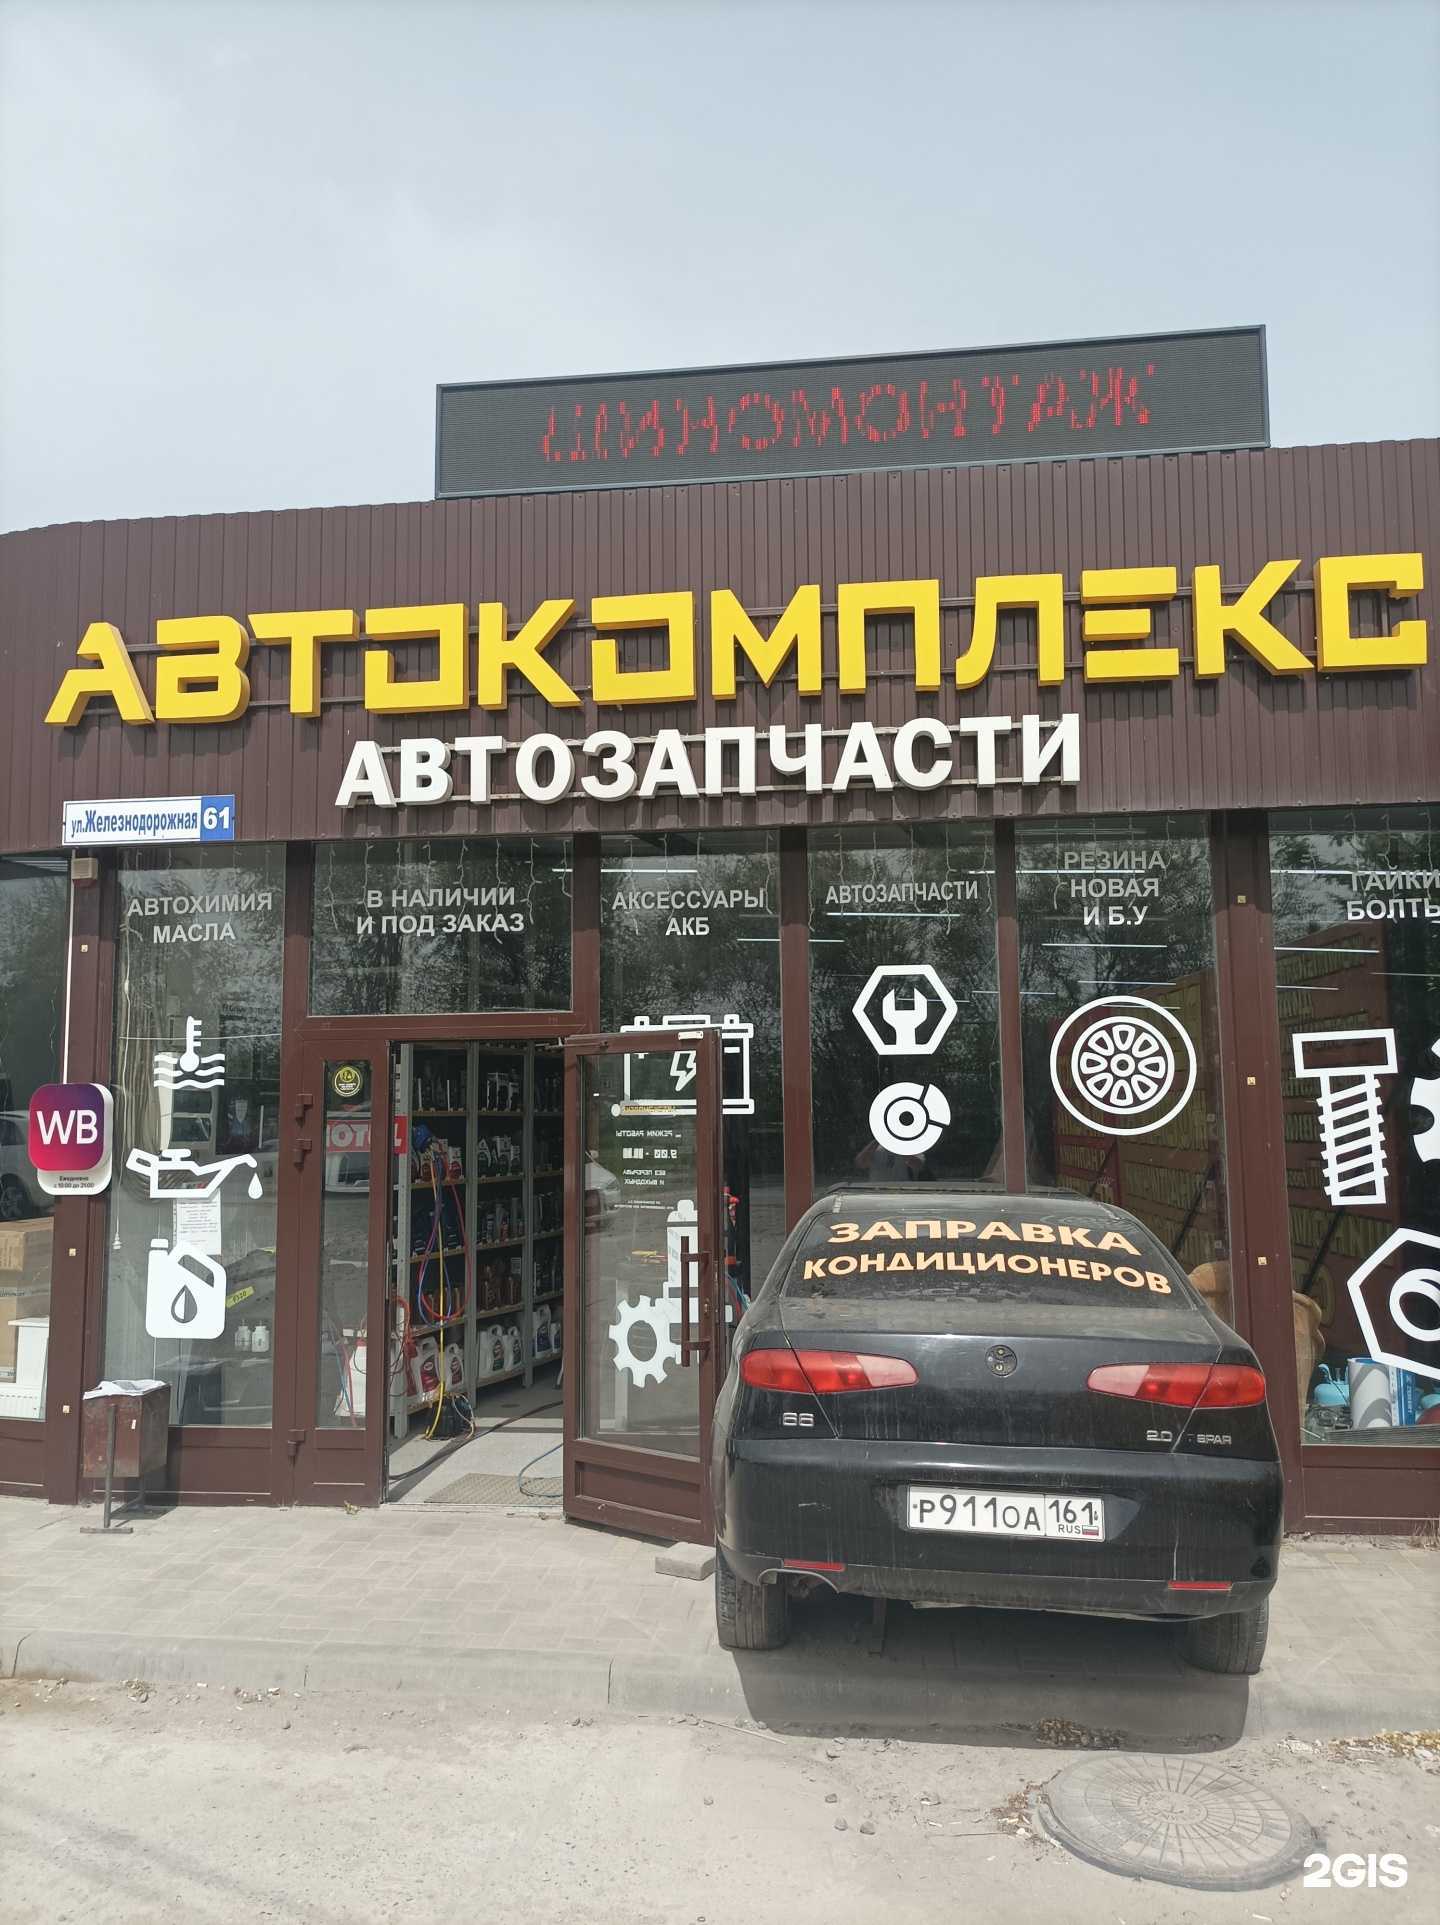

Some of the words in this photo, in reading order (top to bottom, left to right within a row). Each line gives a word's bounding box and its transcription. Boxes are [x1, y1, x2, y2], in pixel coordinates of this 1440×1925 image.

[541, 362, 1156, 462] ШИНОМОНТАЖ
[44, 552, 1428, 726] АВТОКОМПЛЕКС
[335, 713, 1080, 808] АВТОЗАПЧАСТИ
[203, 806, 230, 829] 61
[1064, 851, 1166, 871] РЕЗИНА
[366, 890, 383, 908] В
[392, 887, 516, 908] НАЛИЧИИ
[611, 889, 765, 911] АКСЕССУАРЫ
[825, 880, 980, 905] АВТОЗАПЧАСТИ
[1071, 878, 1160, 898] НОВАЯ
[127, 892, 273, 917] АВТОХИМИЯ
[1083, 905, 1100, 926] И
[1108, 904, 1149, 926] Б.У
[153, 922, 236, 945] МАСЛА
[357, 915, 373, 935] И
[381, 913, 435, 937] ПОД
[441, 911, 525, 935] ЗАКАЗ
[665, 916, 710, 936] АКБ
[36, 1109, 98, 1145] WB
[827, 1219, 1142, 1256] ЗАПРАВКА
[803, 1252, 1171, 1294] КОНДИЦИОНЕРОВ
[1048, 1499, 1094, 1525] 161
[1058, 1523, 1081, 1535] RUS
